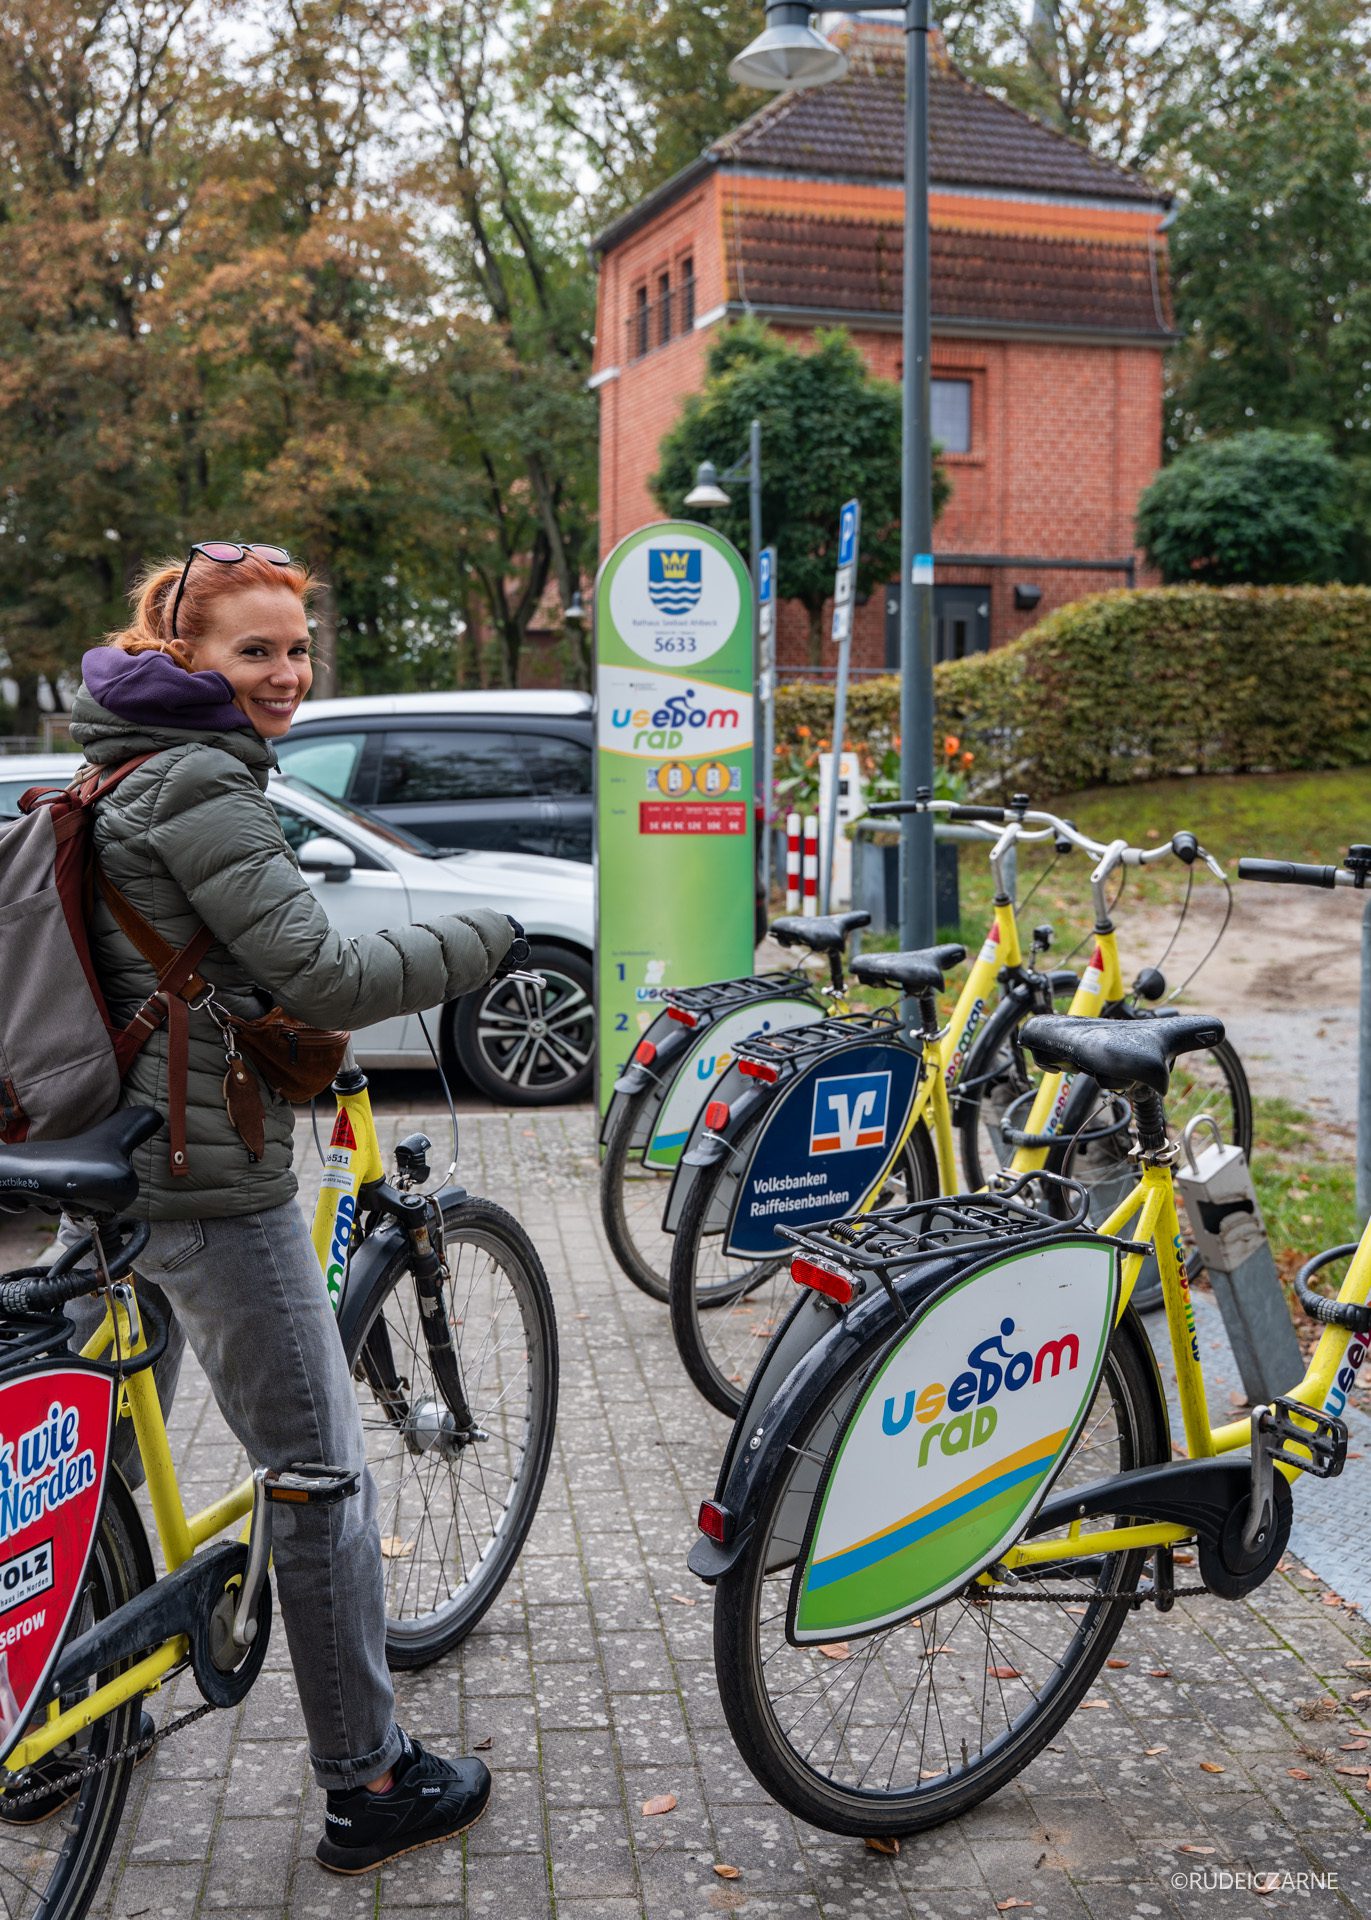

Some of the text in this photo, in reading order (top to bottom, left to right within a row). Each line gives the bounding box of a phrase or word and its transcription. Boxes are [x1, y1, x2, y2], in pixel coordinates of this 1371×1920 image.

[654, 637, 697, 652] 5633
[615, 963, 626, 981] 1
[615, 1013, 628, 1031] 2
[753, 1172, 828, 1194] Volksbanken
[750, 1190, 849, 1217] Raiffeisenbanken
[21, 1407, 76, 1477] wie
[0, 1454, 94, 1538] Norden
